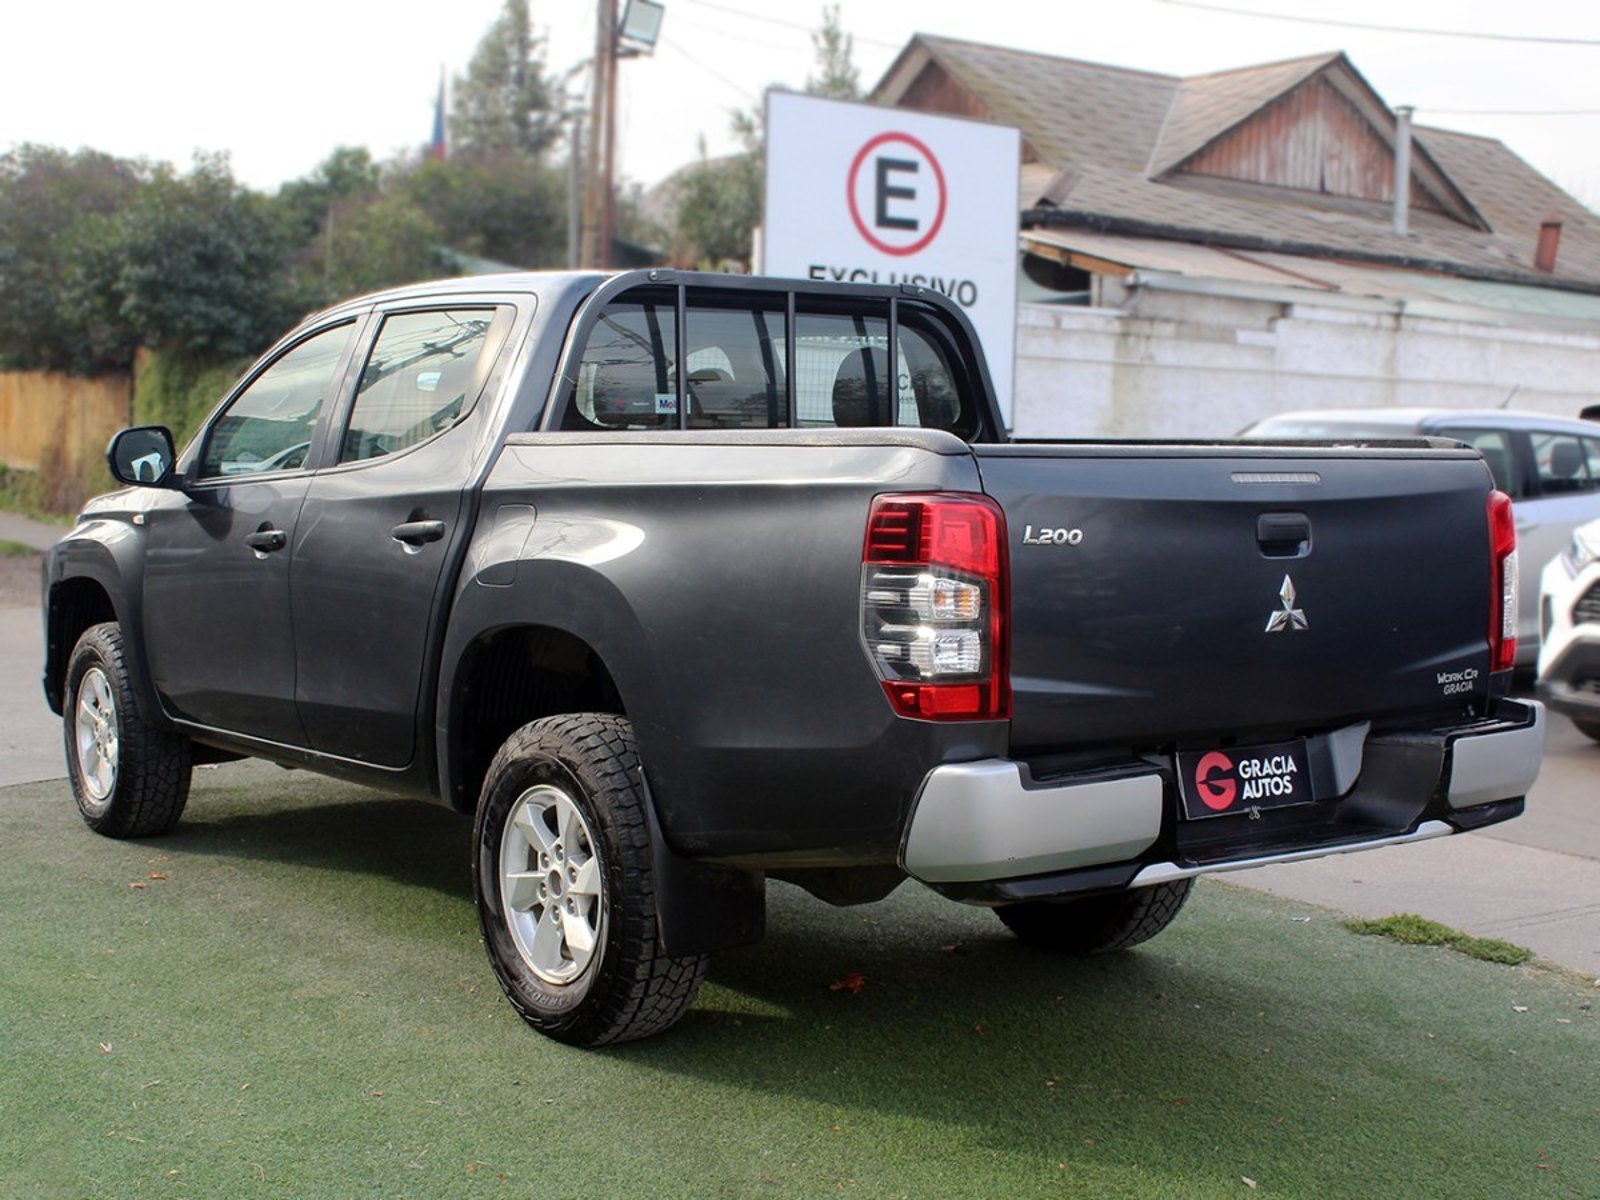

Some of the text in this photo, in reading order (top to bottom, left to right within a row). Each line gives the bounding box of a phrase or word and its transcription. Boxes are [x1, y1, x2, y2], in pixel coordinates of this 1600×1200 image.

[875, 156, 919, 231] E
[1023, 525, 1083, 546] L200
[1443, 680, 1473, 696] GRACIA
[1238, 755, 1297, 779] GRACIA
[1242, 775, 1293, 800] AUTOS
